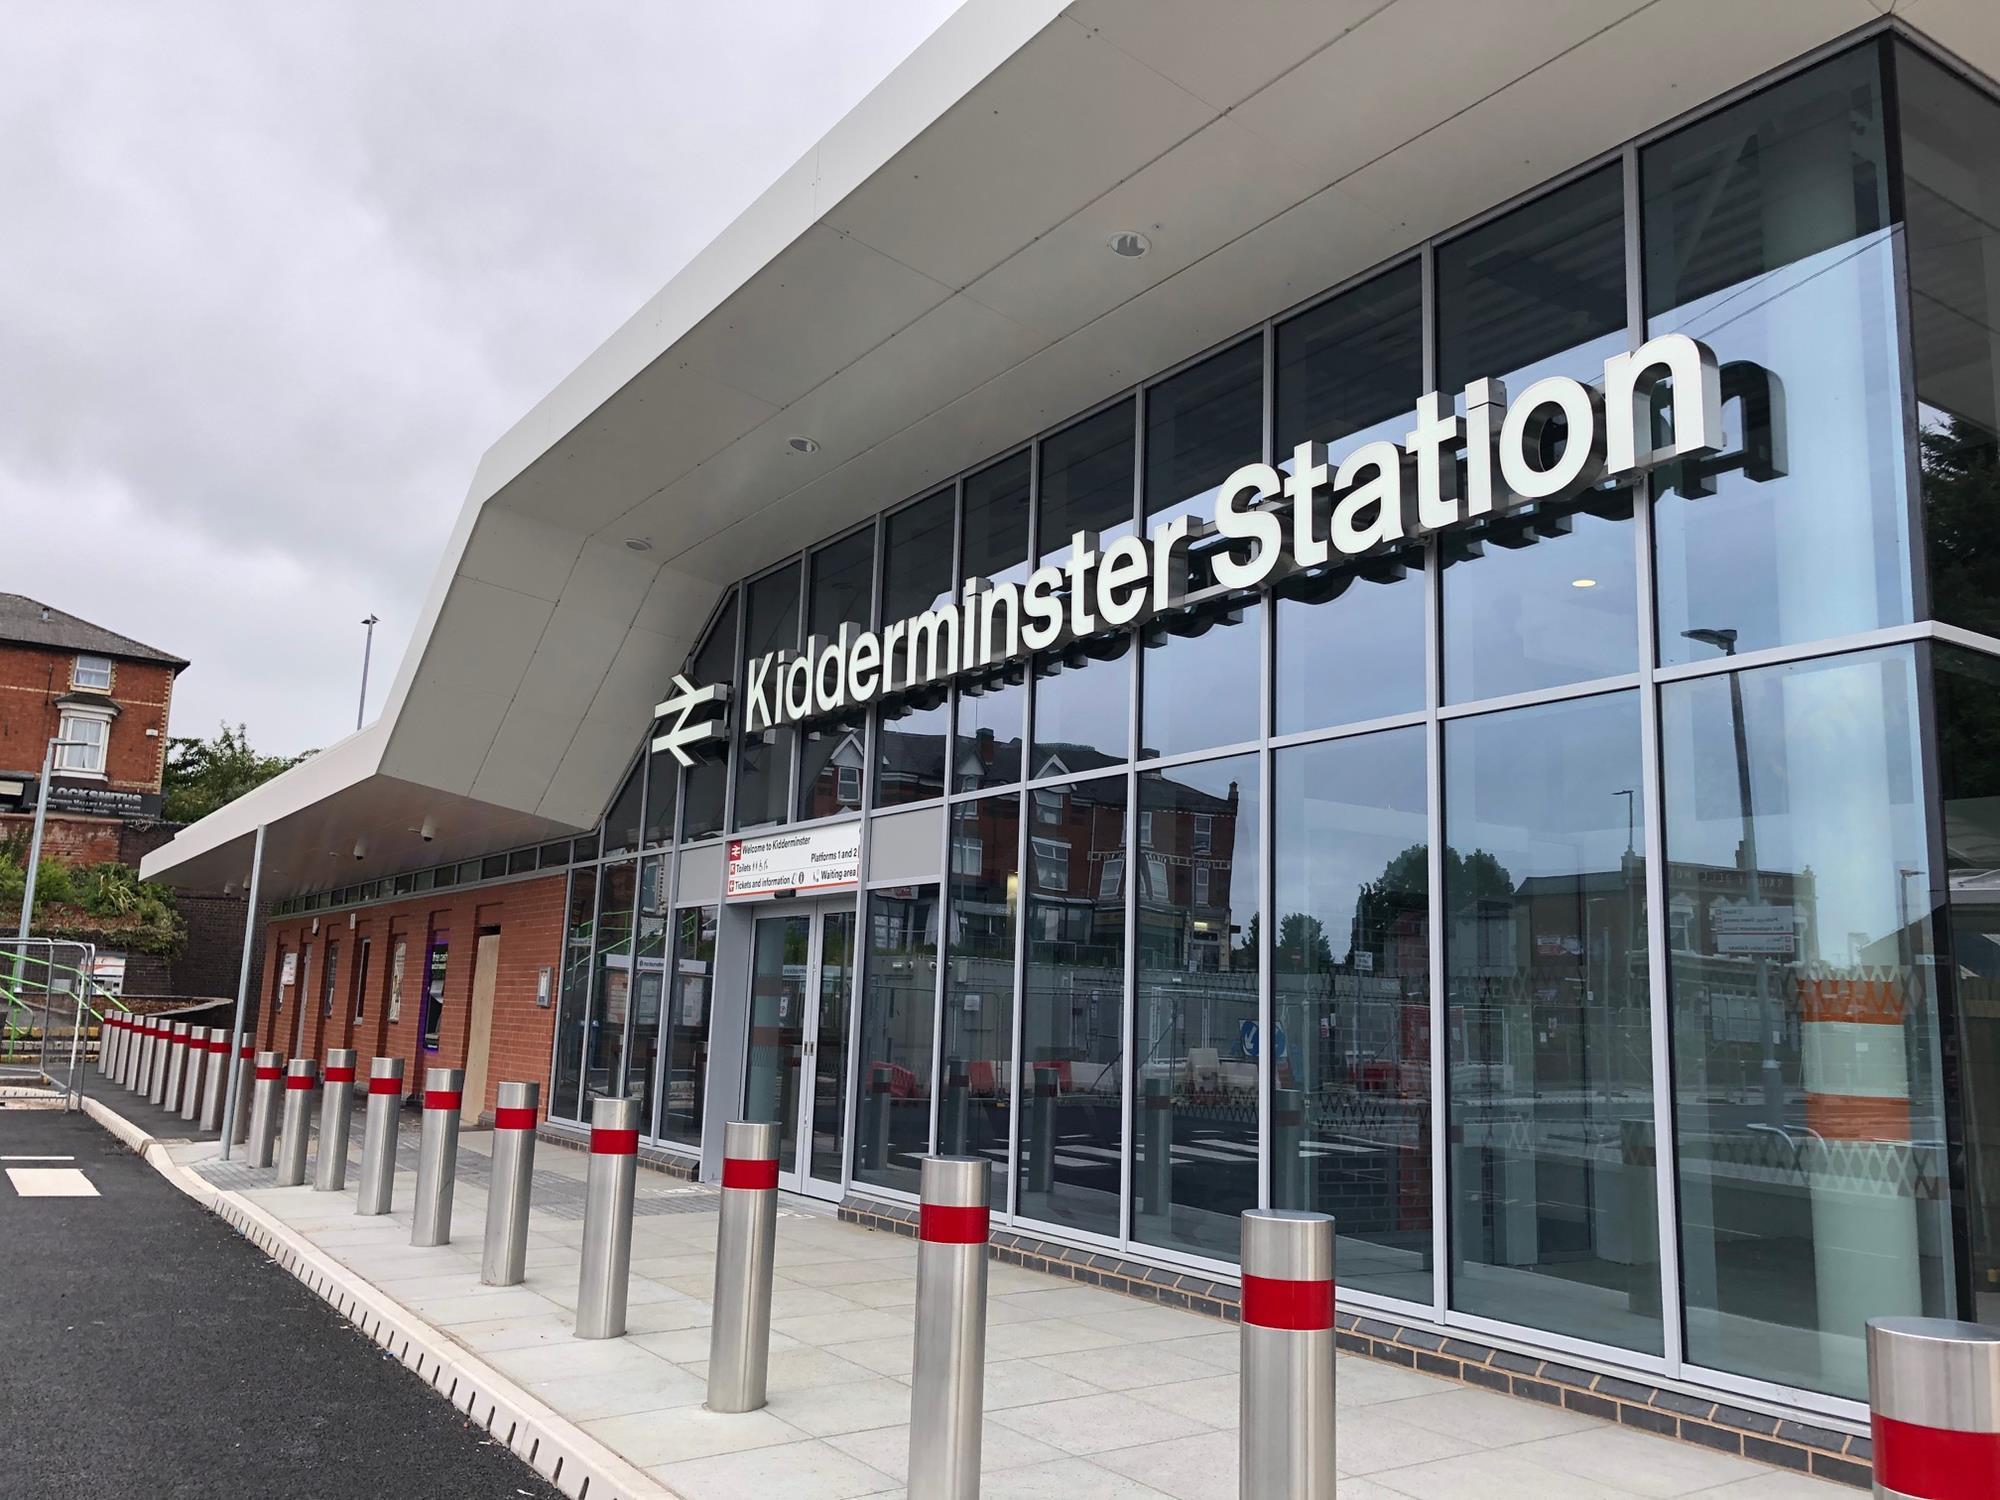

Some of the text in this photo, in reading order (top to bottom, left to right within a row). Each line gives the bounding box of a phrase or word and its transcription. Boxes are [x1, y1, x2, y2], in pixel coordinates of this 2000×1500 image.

[745, 333, 1716, 733] Kidderminster Station
[48, 785, 142, 803] LOCKSMITHS
[742, 837, 811, 855] Welcome to Kidderminster
[811, 850, 838, 862] Platforms
[841, 849, 853, 858] and
[853, 848, 857, 857] 2
[736, 863, 752, 873] Toilets
[820, 869, 856, 881] Waiting area
[735, 876, 790, 890] Tickets and information
